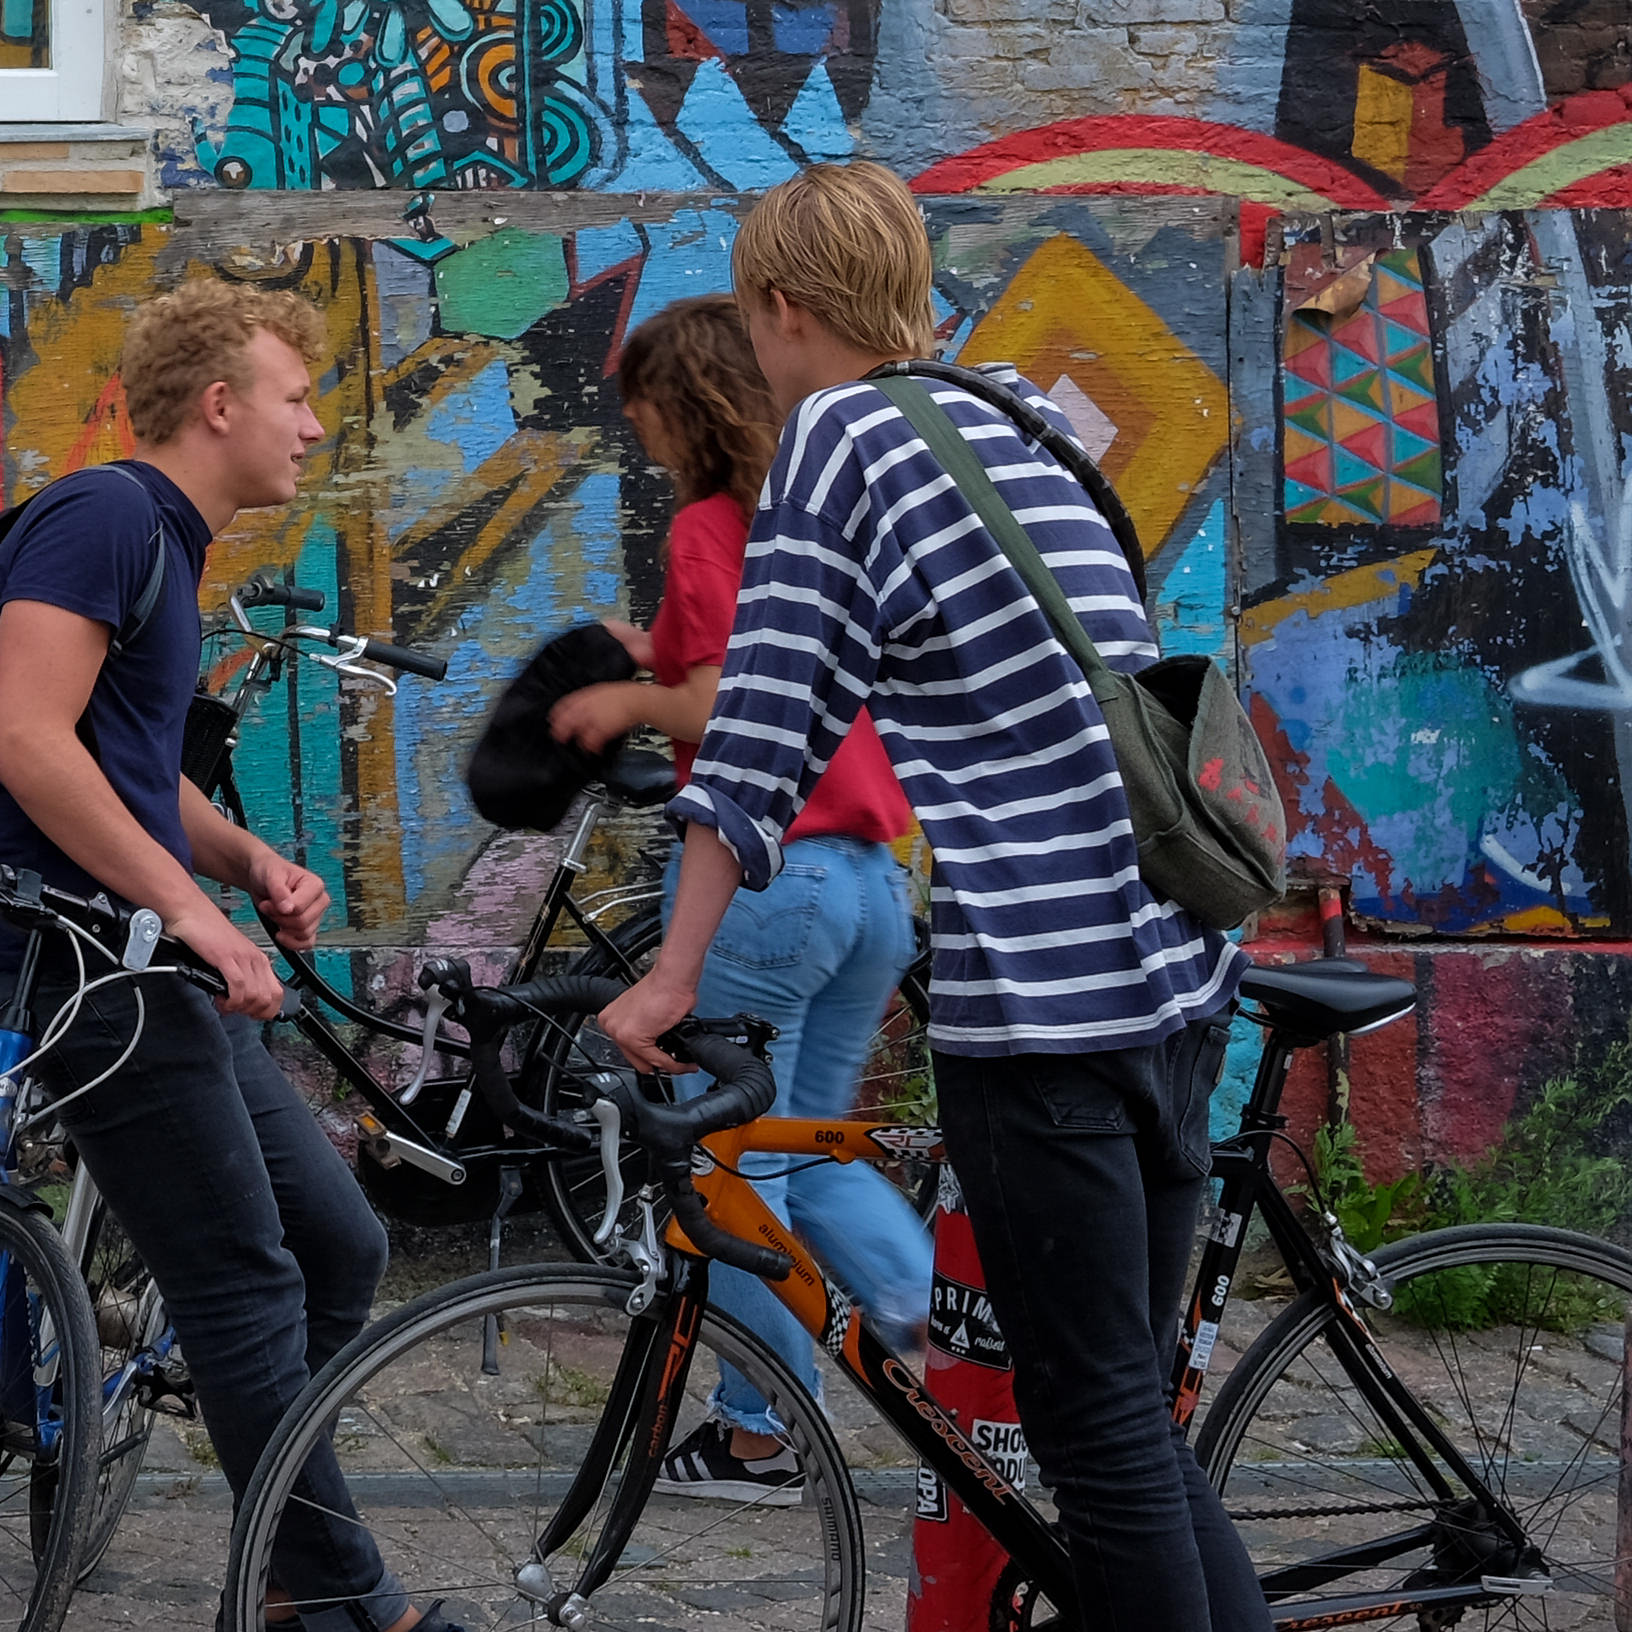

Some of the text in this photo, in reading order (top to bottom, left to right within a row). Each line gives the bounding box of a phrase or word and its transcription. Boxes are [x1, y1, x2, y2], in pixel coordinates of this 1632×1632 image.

[815, 1130, 845, 1145] 600
[1211, 1275, 1231, 1308] 600
[647, 1404, 669, 1458] carbon
[882, 1358, 1007, 1506] Crescent
[977, 1424, 1026, 1454] SHO
[821, 1496, 841, 1562] SHIMANO
[1282, 1601, 1404, 1630] rescent
